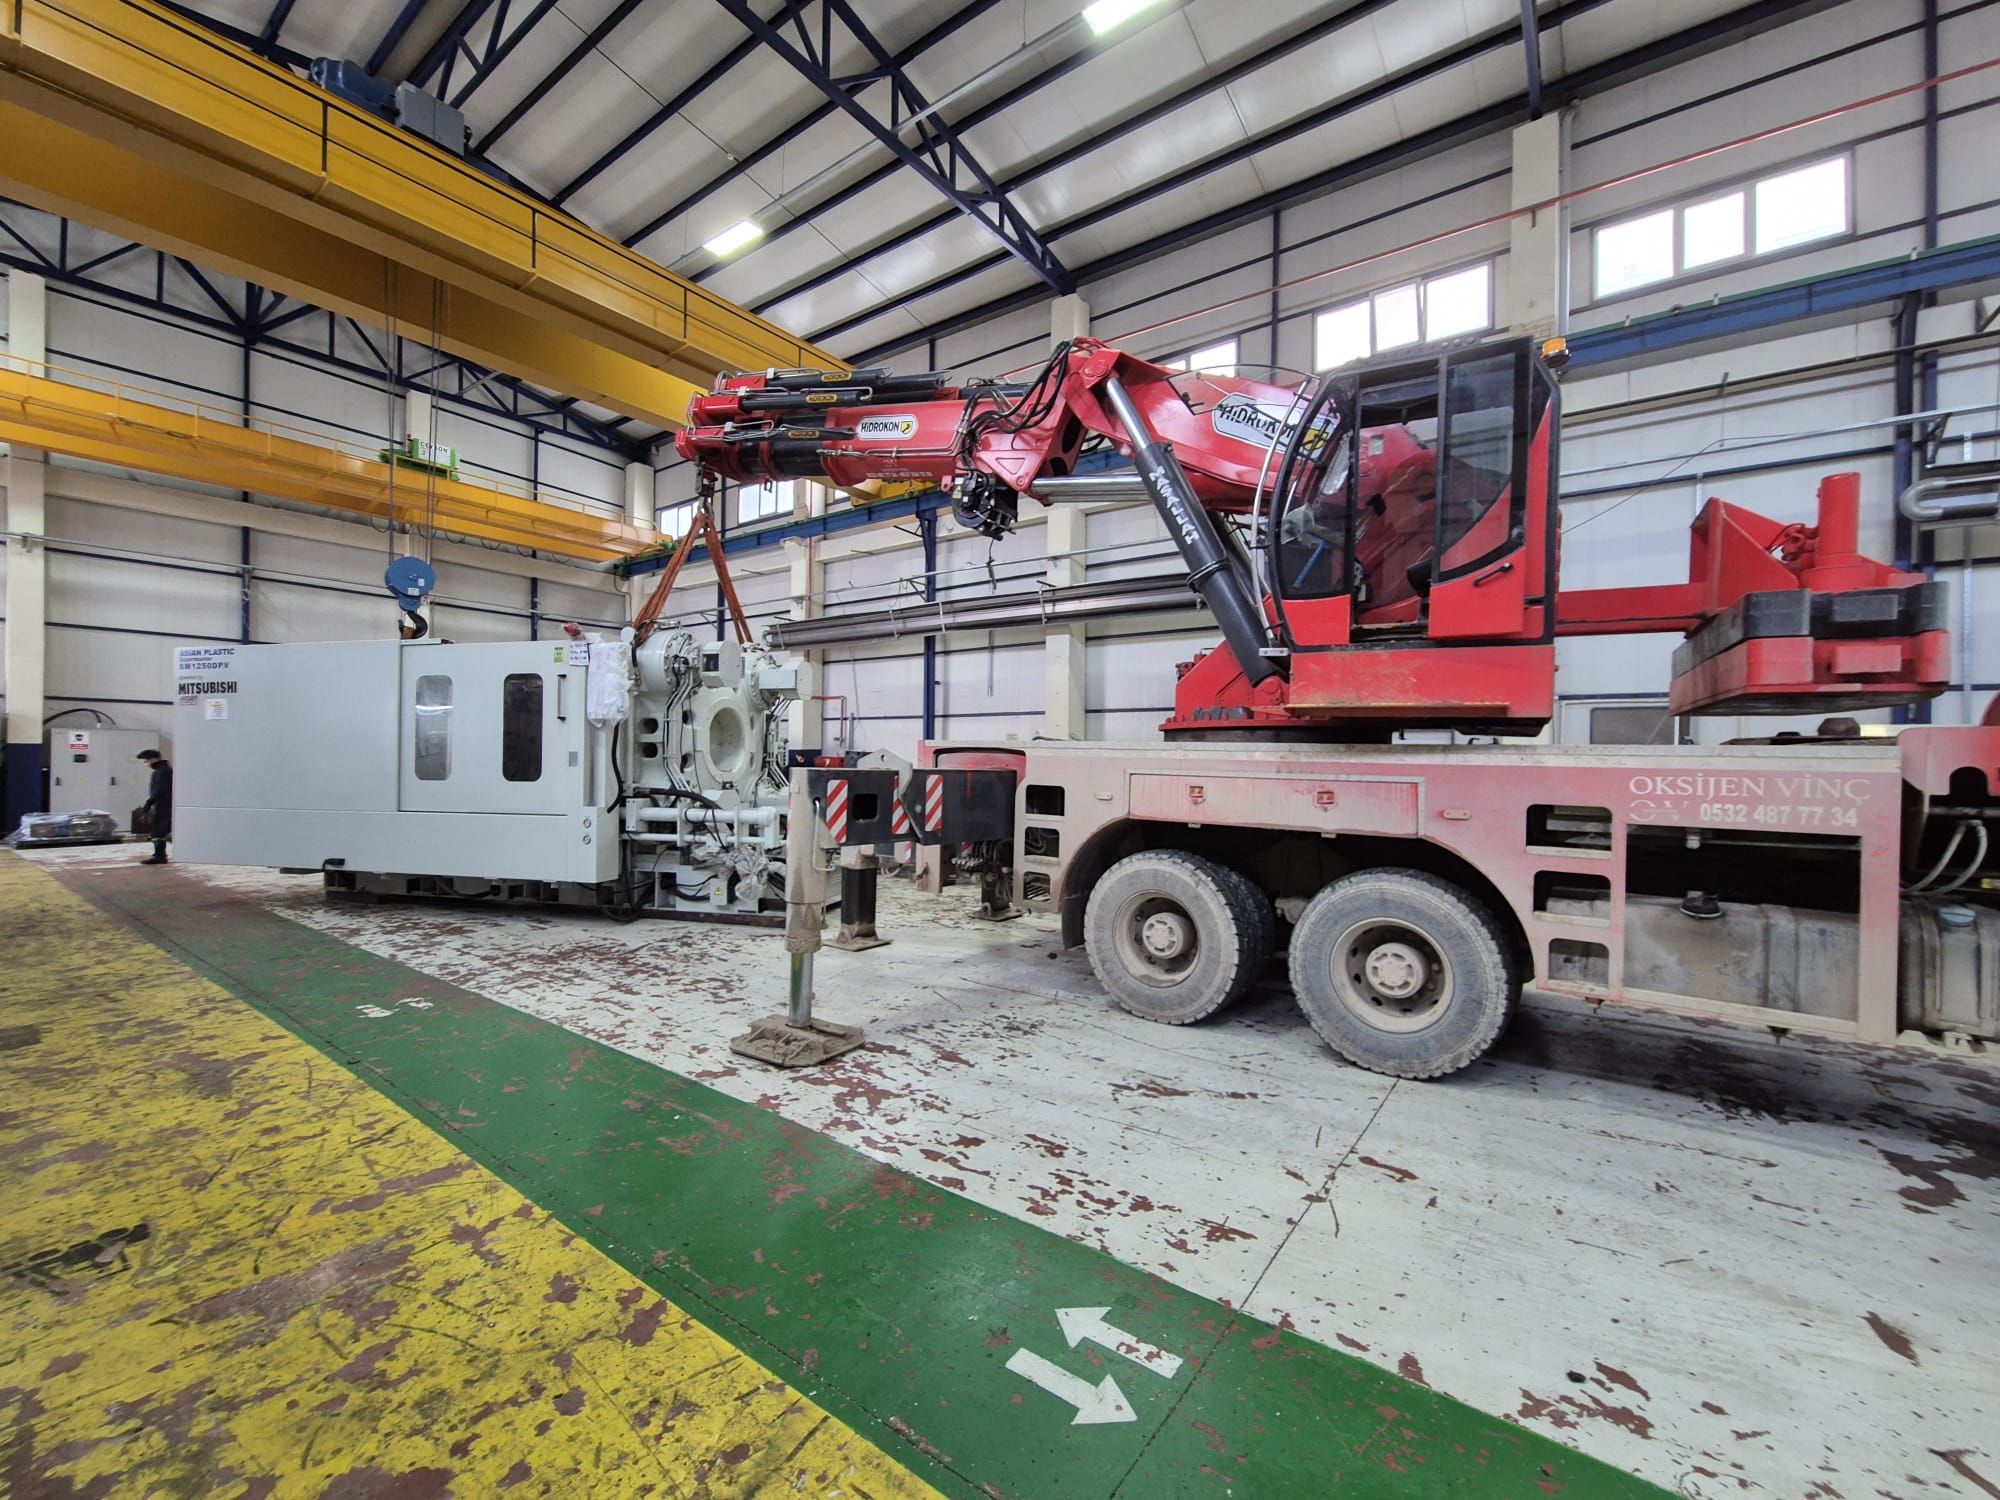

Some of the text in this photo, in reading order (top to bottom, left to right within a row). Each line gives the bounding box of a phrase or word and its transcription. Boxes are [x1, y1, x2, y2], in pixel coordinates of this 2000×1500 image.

[204, 648, 235, 656] PLASTIC
[178, 681, 237, 695] MITSUBISHI
[1700, 803, 1857, 827] 0532 487 77 34
